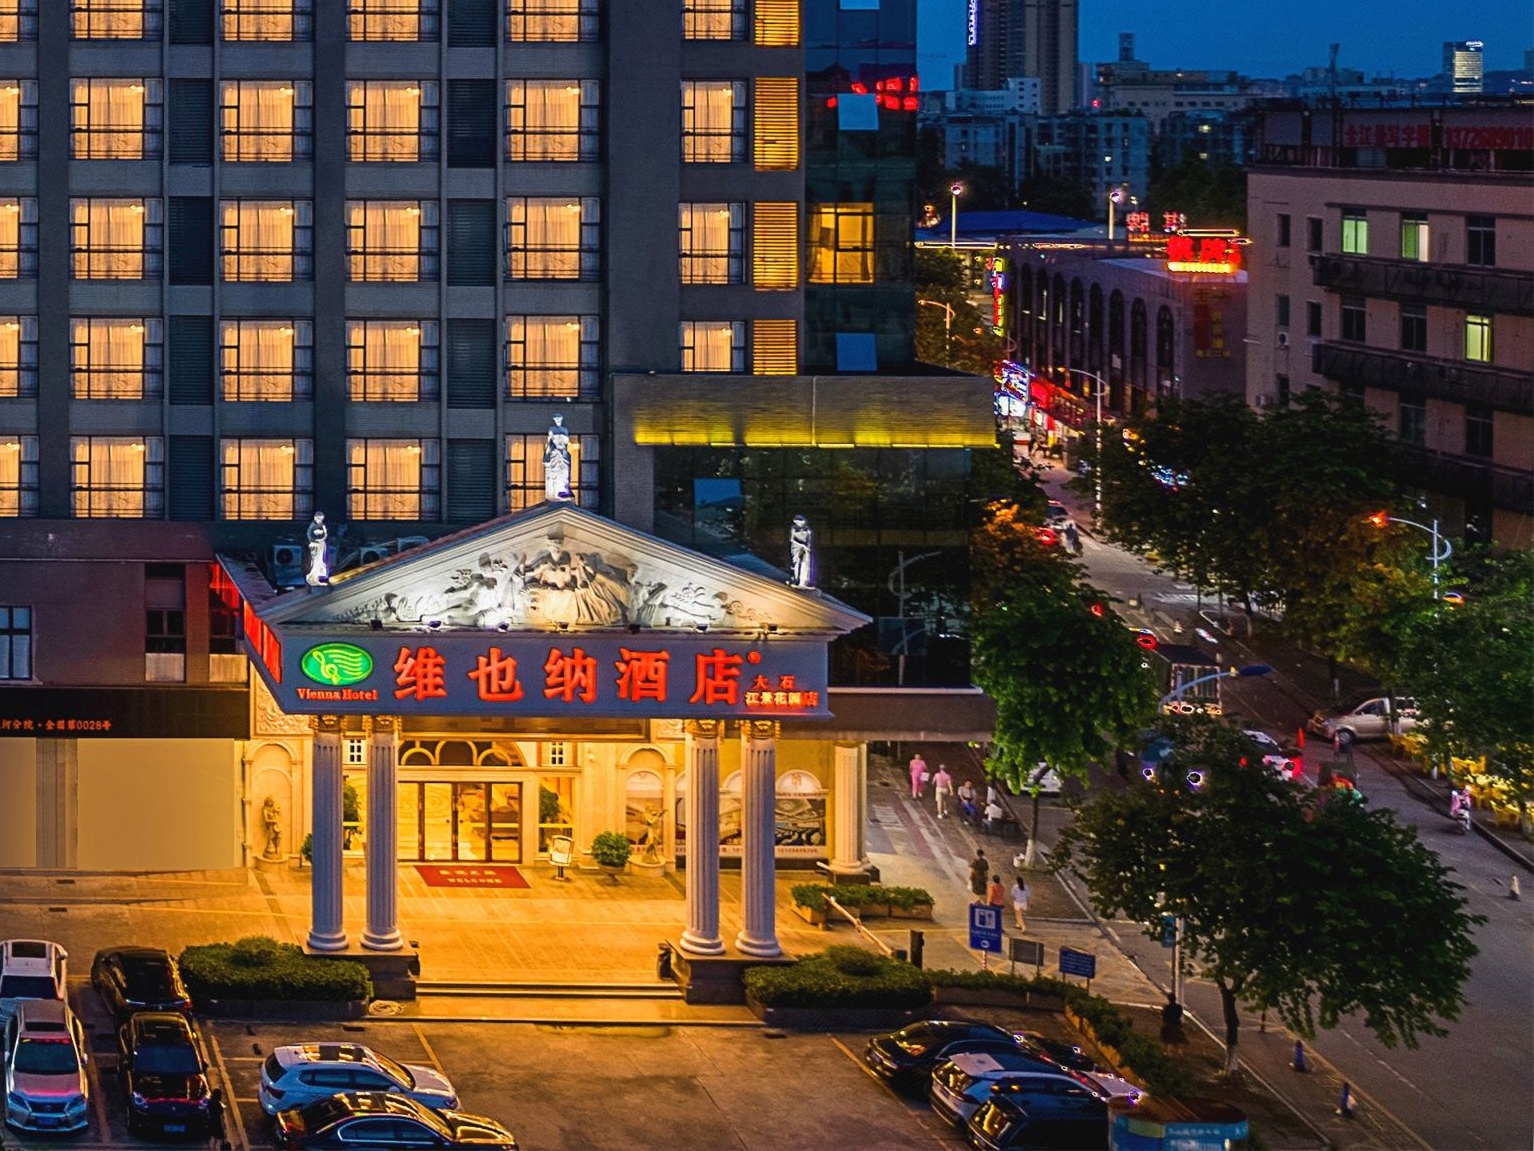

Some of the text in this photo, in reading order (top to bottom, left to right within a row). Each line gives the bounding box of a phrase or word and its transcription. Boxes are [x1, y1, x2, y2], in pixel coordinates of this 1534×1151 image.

[394, 646, 743, 705] 维也纳酒店
[297, 688, 378, 700] Vienna Hotel
